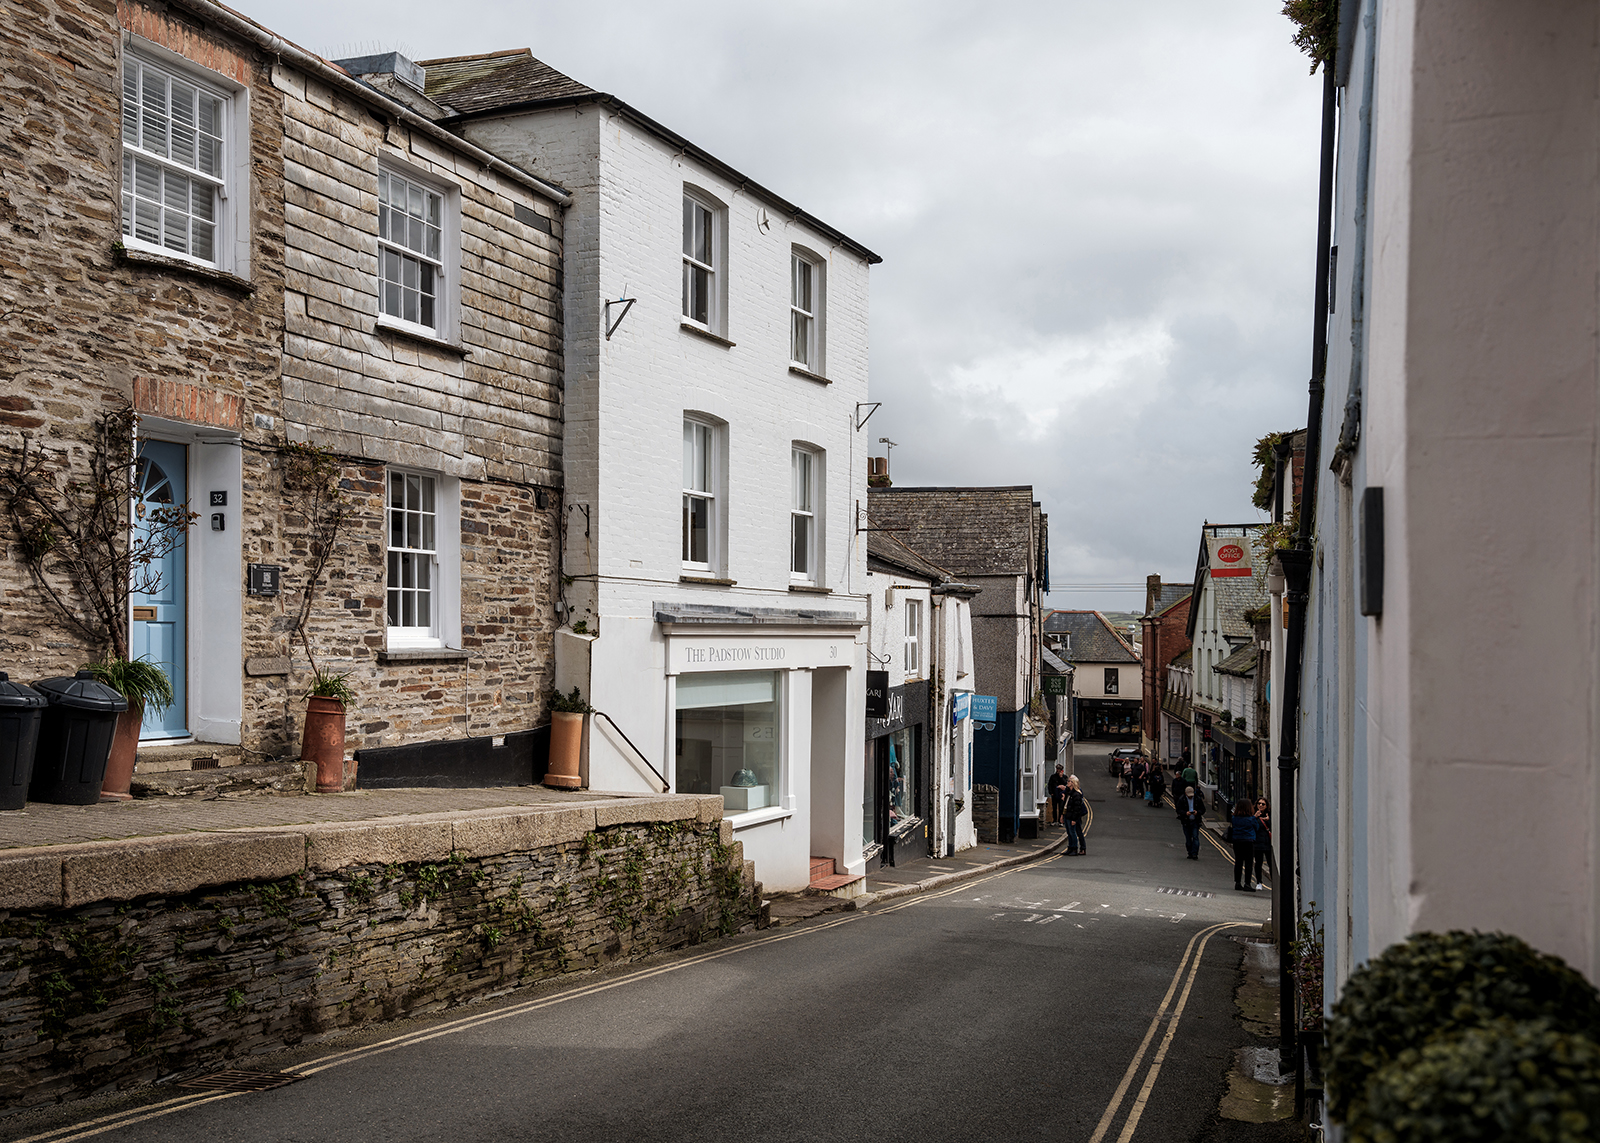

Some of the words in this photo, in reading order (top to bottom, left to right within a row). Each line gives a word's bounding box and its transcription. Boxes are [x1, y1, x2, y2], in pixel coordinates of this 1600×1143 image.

[212, 493, 223, 504] 32
[685, 647, 706, 662] THE
[708, 647, 752, 662] PADSTOW
[754, 646, 786, 661] STUDIO
[829, 646, 838, 658] 30
[973, 697, 995, 705] HUXTER
